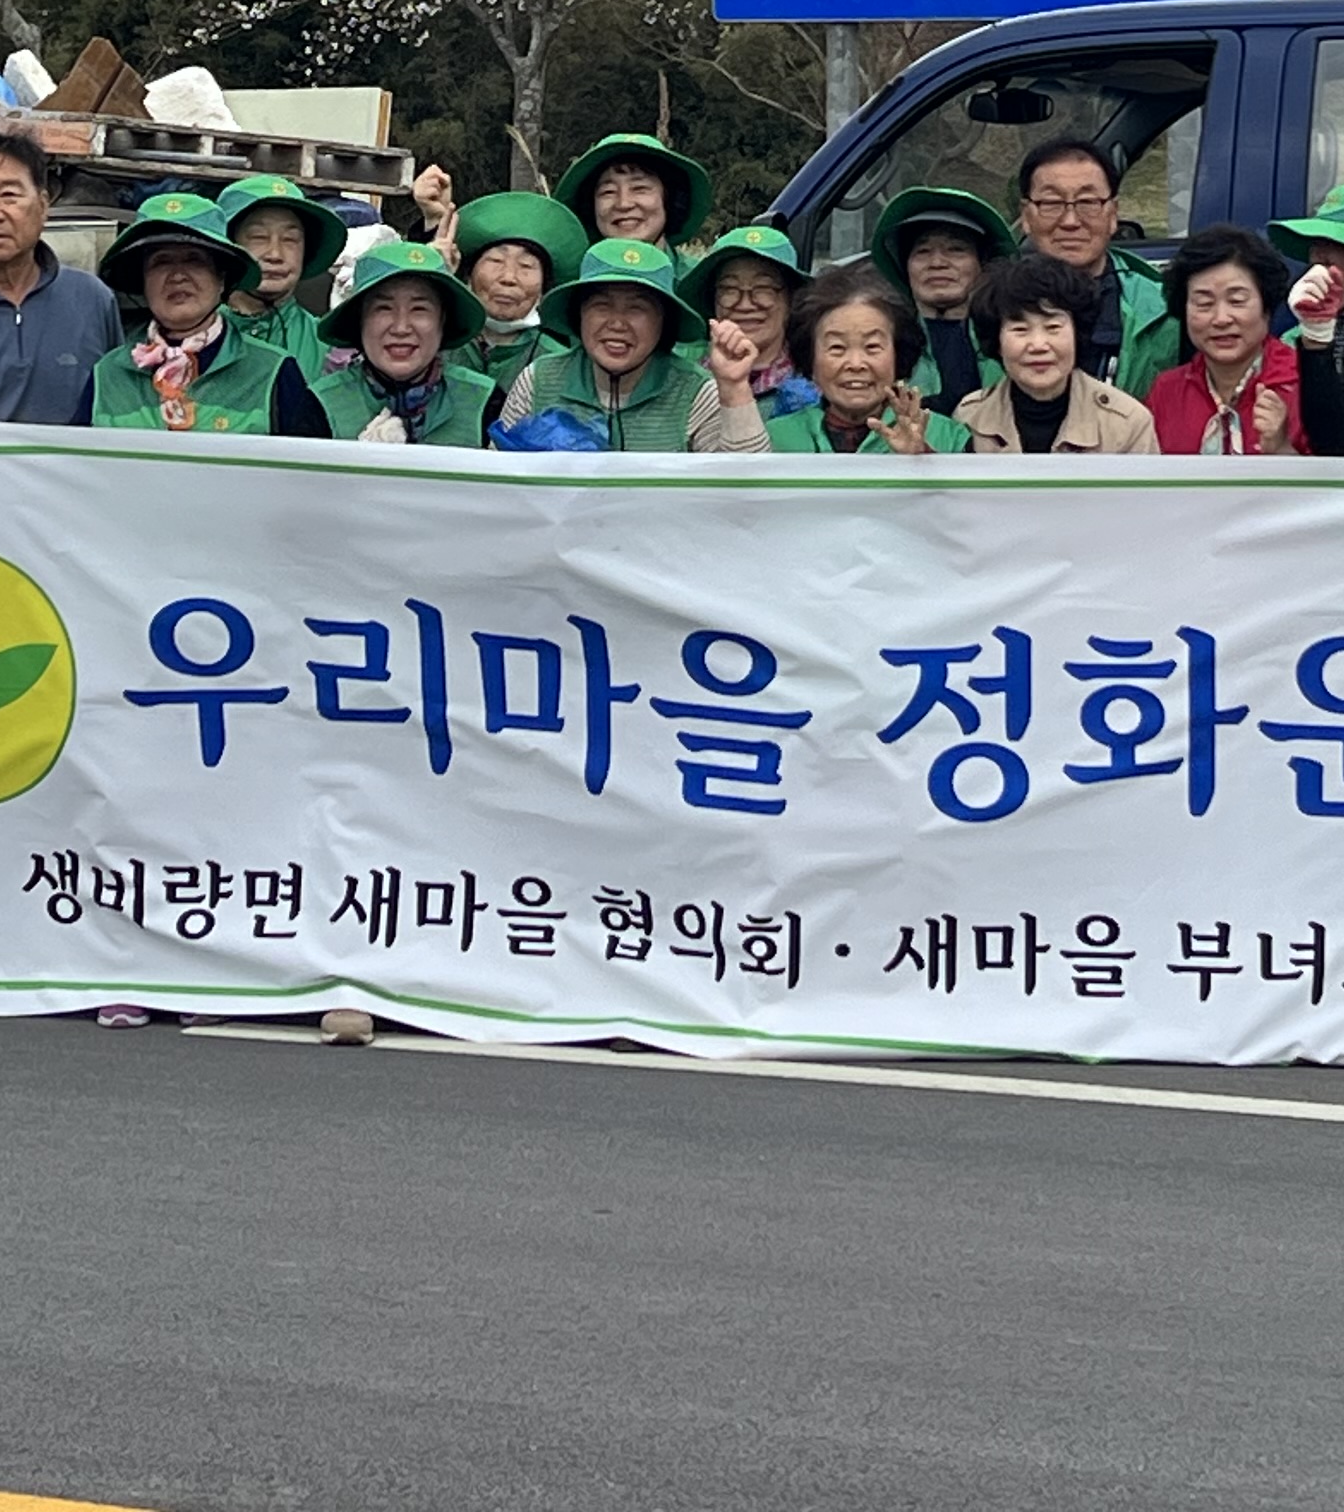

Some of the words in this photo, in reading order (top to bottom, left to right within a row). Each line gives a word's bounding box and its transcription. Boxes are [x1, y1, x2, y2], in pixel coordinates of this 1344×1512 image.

[123, 597, 813, 816] 우리마을
[22, 849, 305, 939] 생비량면
[330, 867, 568, 957] 새마을
[592, 885, 801, 989] 협의회
[883, 912, 1137, 998] 새마을
